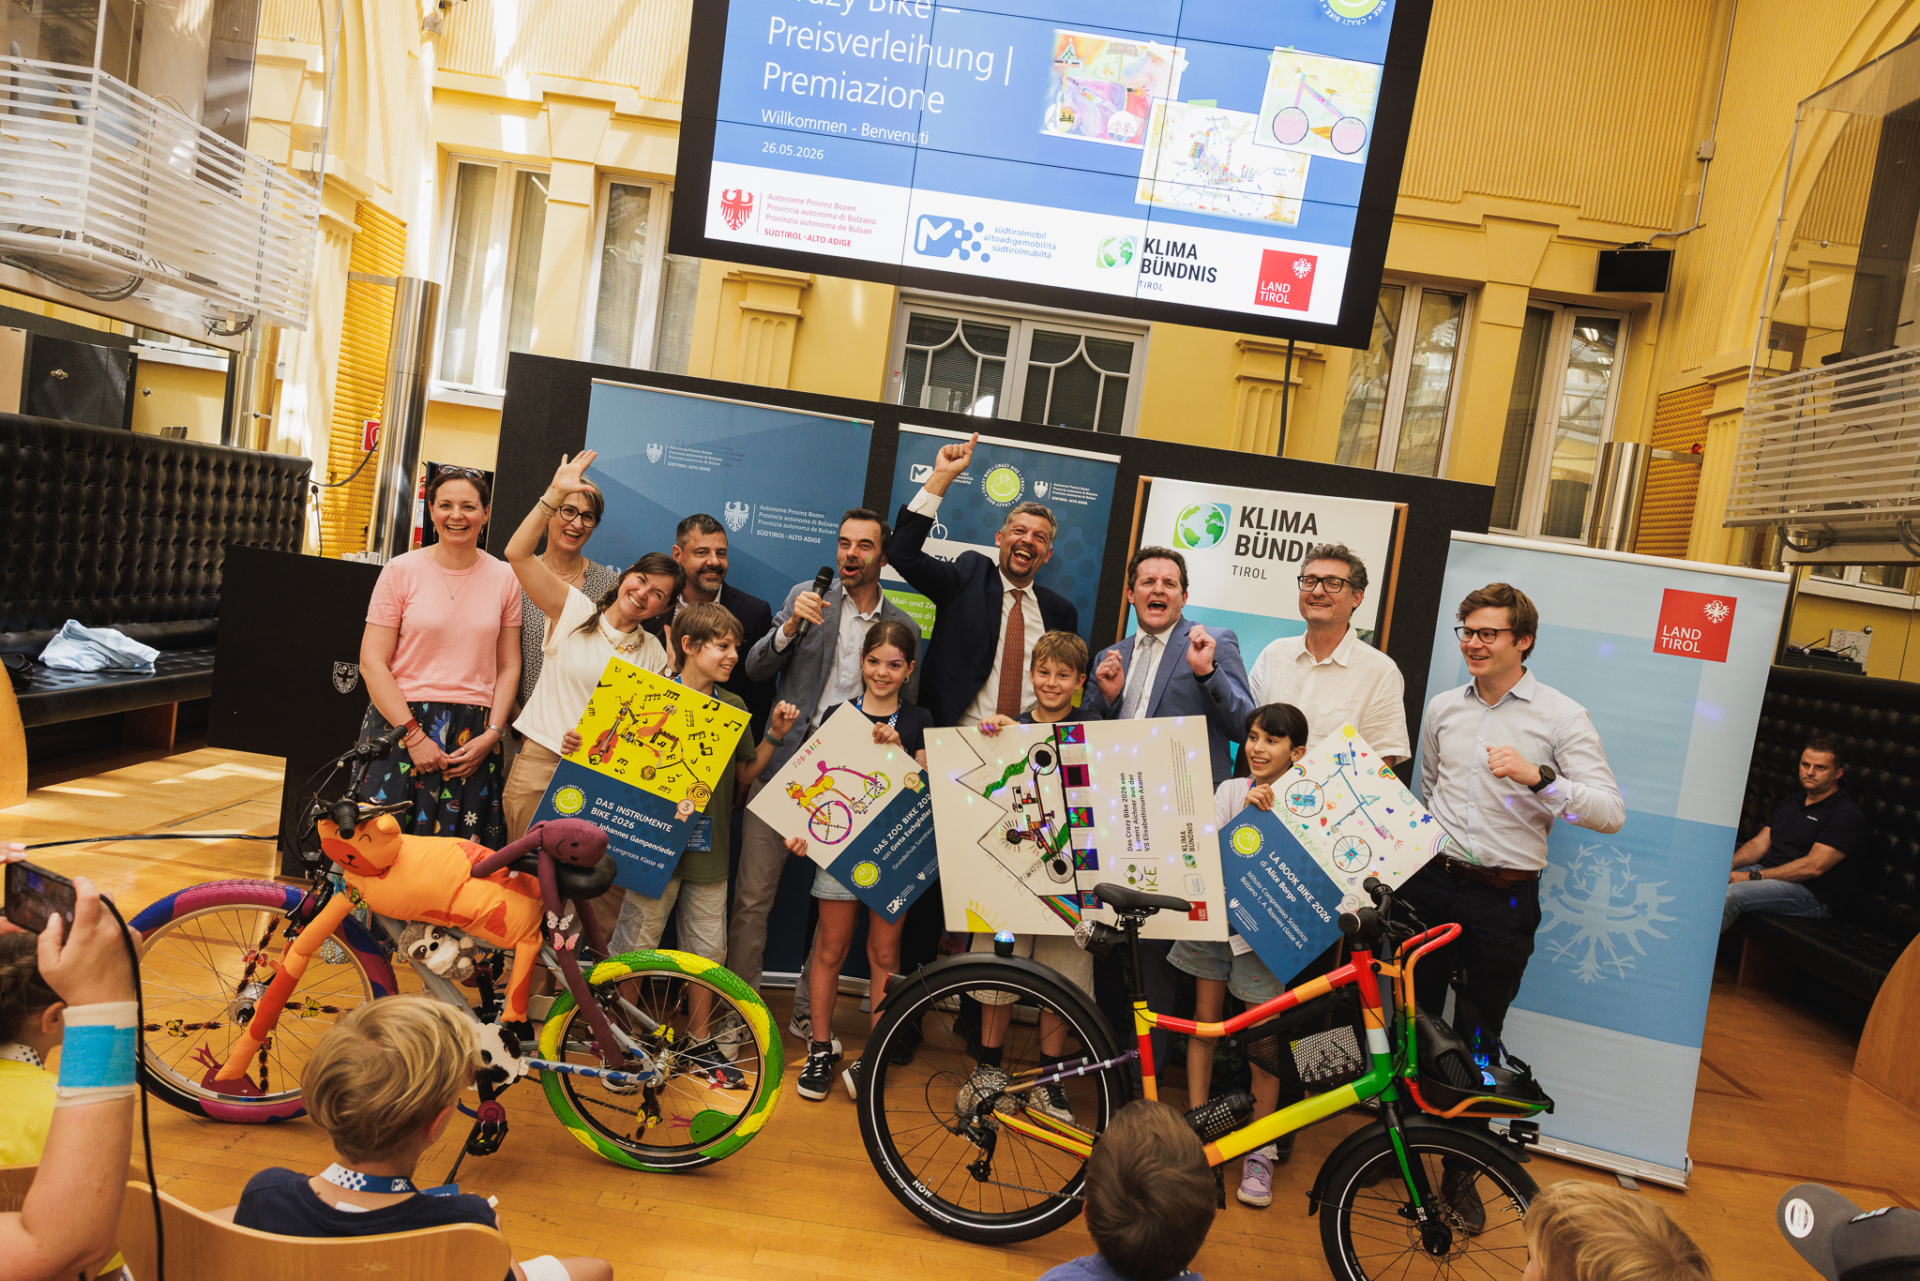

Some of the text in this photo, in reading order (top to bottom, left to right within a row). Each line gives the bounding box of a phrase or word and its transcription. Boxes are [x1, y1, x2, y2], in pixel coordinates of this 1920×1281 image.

[1325, 8, 1367, 26] CRAZY BIKE
[768, 16, 995, 82] Preisverleihung
[762, 62, 945, 114] Premiazione
[761, 108, 848, 134] Willkommen
[861, 122, 929, 145] Benvenuti
[762, 141, 824, 161] 26.05.2026
[768, 193, 856, 212] Autonome Provinz Bozen
[765, 213, 872, 235] Provinzia autonoma de Bulsan
[767, 203, 877, 225] Provincia autonoma di Bolzano
[764, 228, 852, 247] SÜDTIROL ALTO ADIGE
[994, 226, 1047, 240] südtirolmobil
[1143, 237, 1199, 261] KLIMA
[1141, 257, 1219, 284] BÜNDNIS
[1138, 280, 1164, 292] TIROL
[1261, 279, 1292, 294] LAND
[1259, 291, 1290, 305] TIROL
[758, 511, 783, 521] Provincia
[784, 516, 811, 525] autonoma
[817, 520, 840, 528] Bolzano
[759, 504, 825, 519] Autonome Provinz Bozen
[1239, 505, 1319, 536] KLIMA
[756, 529, 785, 539] SÜDTIROL
[803, 536, 822, 544] ADIGE
[783, 523, 810, 532] autonoma
[818, 527, 837, 535] Bulsan
[1231, 565, 1268, 580] TIROL
[891, 597, 908, 605] Mal-
[909, 599, 924, 608] und
[924, 612, 932, 620] di
[1662, 625, 1702, 640] LAND
[1661, 636, 1701, 653] TIROL
[907, 776, 917, 785] 1
[595, 797, 673, 833] DAS INSTRUMENTE
[682, 802, 690, 811] 3
[1137, 771, 1150, 852] VS Elisabethinum Axams
[590, 806, 635, 830] BIKE 2026
[872, 793, 932, 855] DAS ZOO BIKE 202
[598, 822, 629, 840] Johannes
[629, 834, 676, 857] Gampenrieder
[1125, 820, 1133, 838] Crazy
[612, 843, 640, 861] Lengmoos
[640, 855, 656, 867] Klasse
[881, 850, 892, 861] von
[890, 836, 906, 852] Greta
[892, 844, 917, 870] Grundschule
[1144, 866, 1159, 892] IKE
[1259, 860, 1297, 903] di Alice Borgo
[1268, 851, 1332, 923] LA BOOK BIKE 2026
[1246, 870, 1263, 889] Istituto
[1261, 887, 1288, 920] Comprensivo
[1346, 898, 1356, 909] 2
[1240, 876, 1258, 898] Bolzano
[1266, 907, 1285, 928] Rosmini
[1282, 926, 1296, 942] classe
[1294, 940, 1303, 950] 4A
